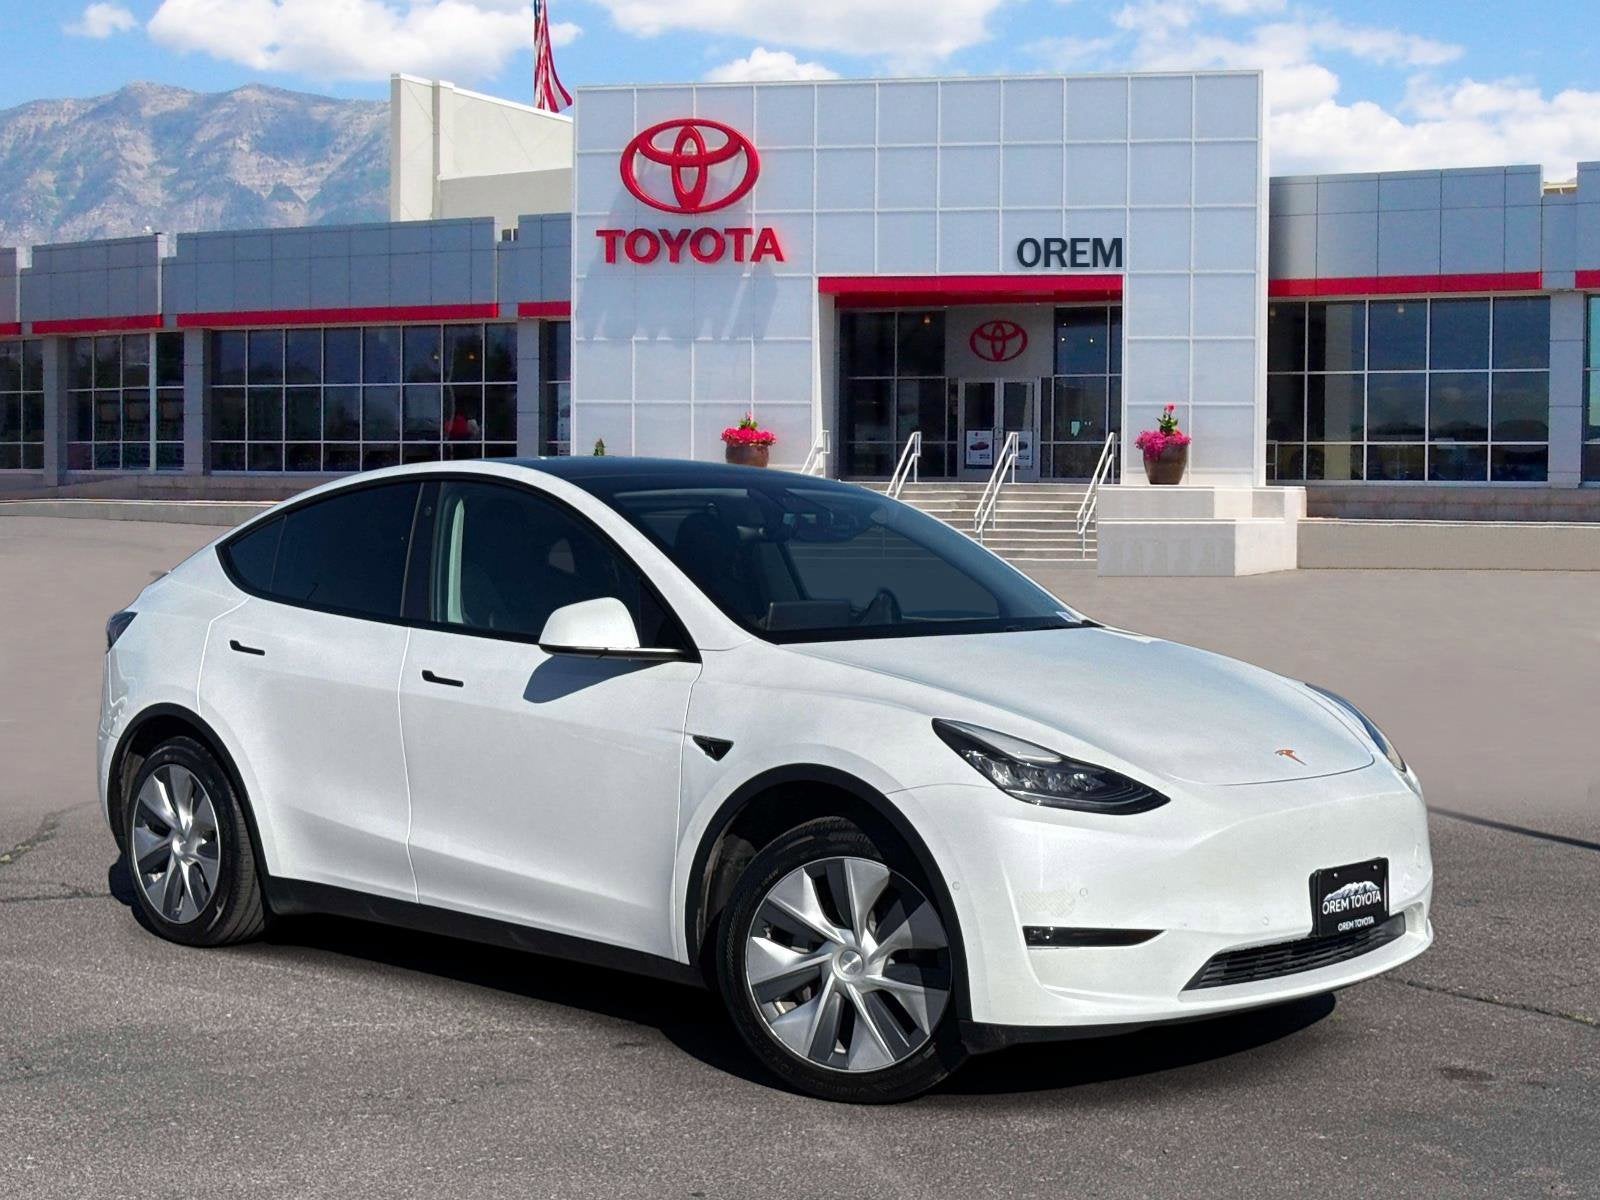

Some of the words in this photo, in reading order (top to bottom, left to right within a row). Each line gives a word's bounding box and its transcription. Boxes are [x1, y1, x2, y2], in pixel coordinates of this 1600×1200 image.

[596, 227, 785, 264] TOYOTA
[1017, 237, 1123, 268] OREM
[1322, 898, 1350, 914] OREM
[1351, 891, 1381, 908] TOYOTA
[1338, 921, 1354, 931] OREM
[1354, 916, 1375, 927] TOYOTA
